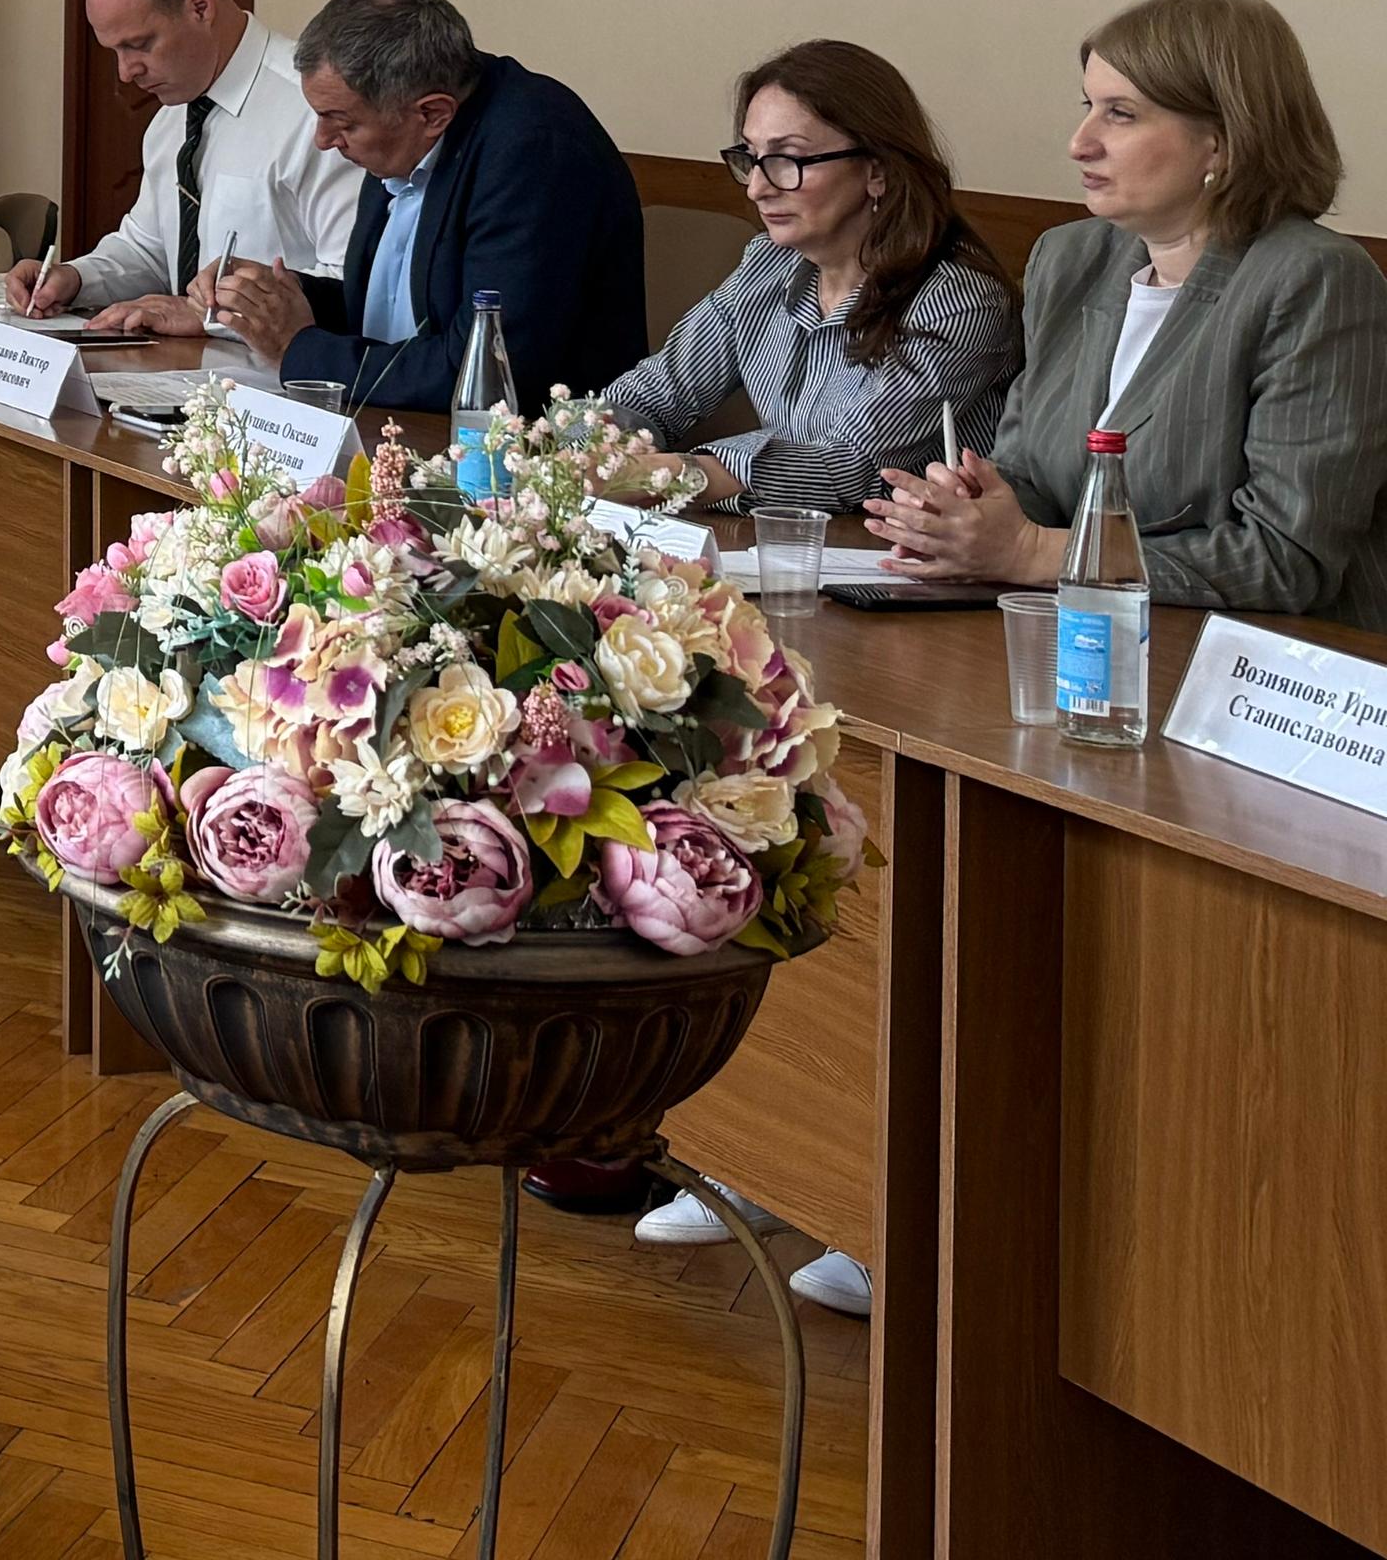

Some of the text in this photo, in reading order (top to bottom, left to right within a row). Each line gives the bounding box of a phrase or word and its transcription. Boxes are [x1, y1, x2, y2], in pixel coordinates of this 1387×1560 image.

[18, 349, 50, 375] Виктор
[281, 422, 320, 448] Оксана
[1341, 690, 1387, 727] Ири
[1229, 694, 1386, 767] Станиславовна
